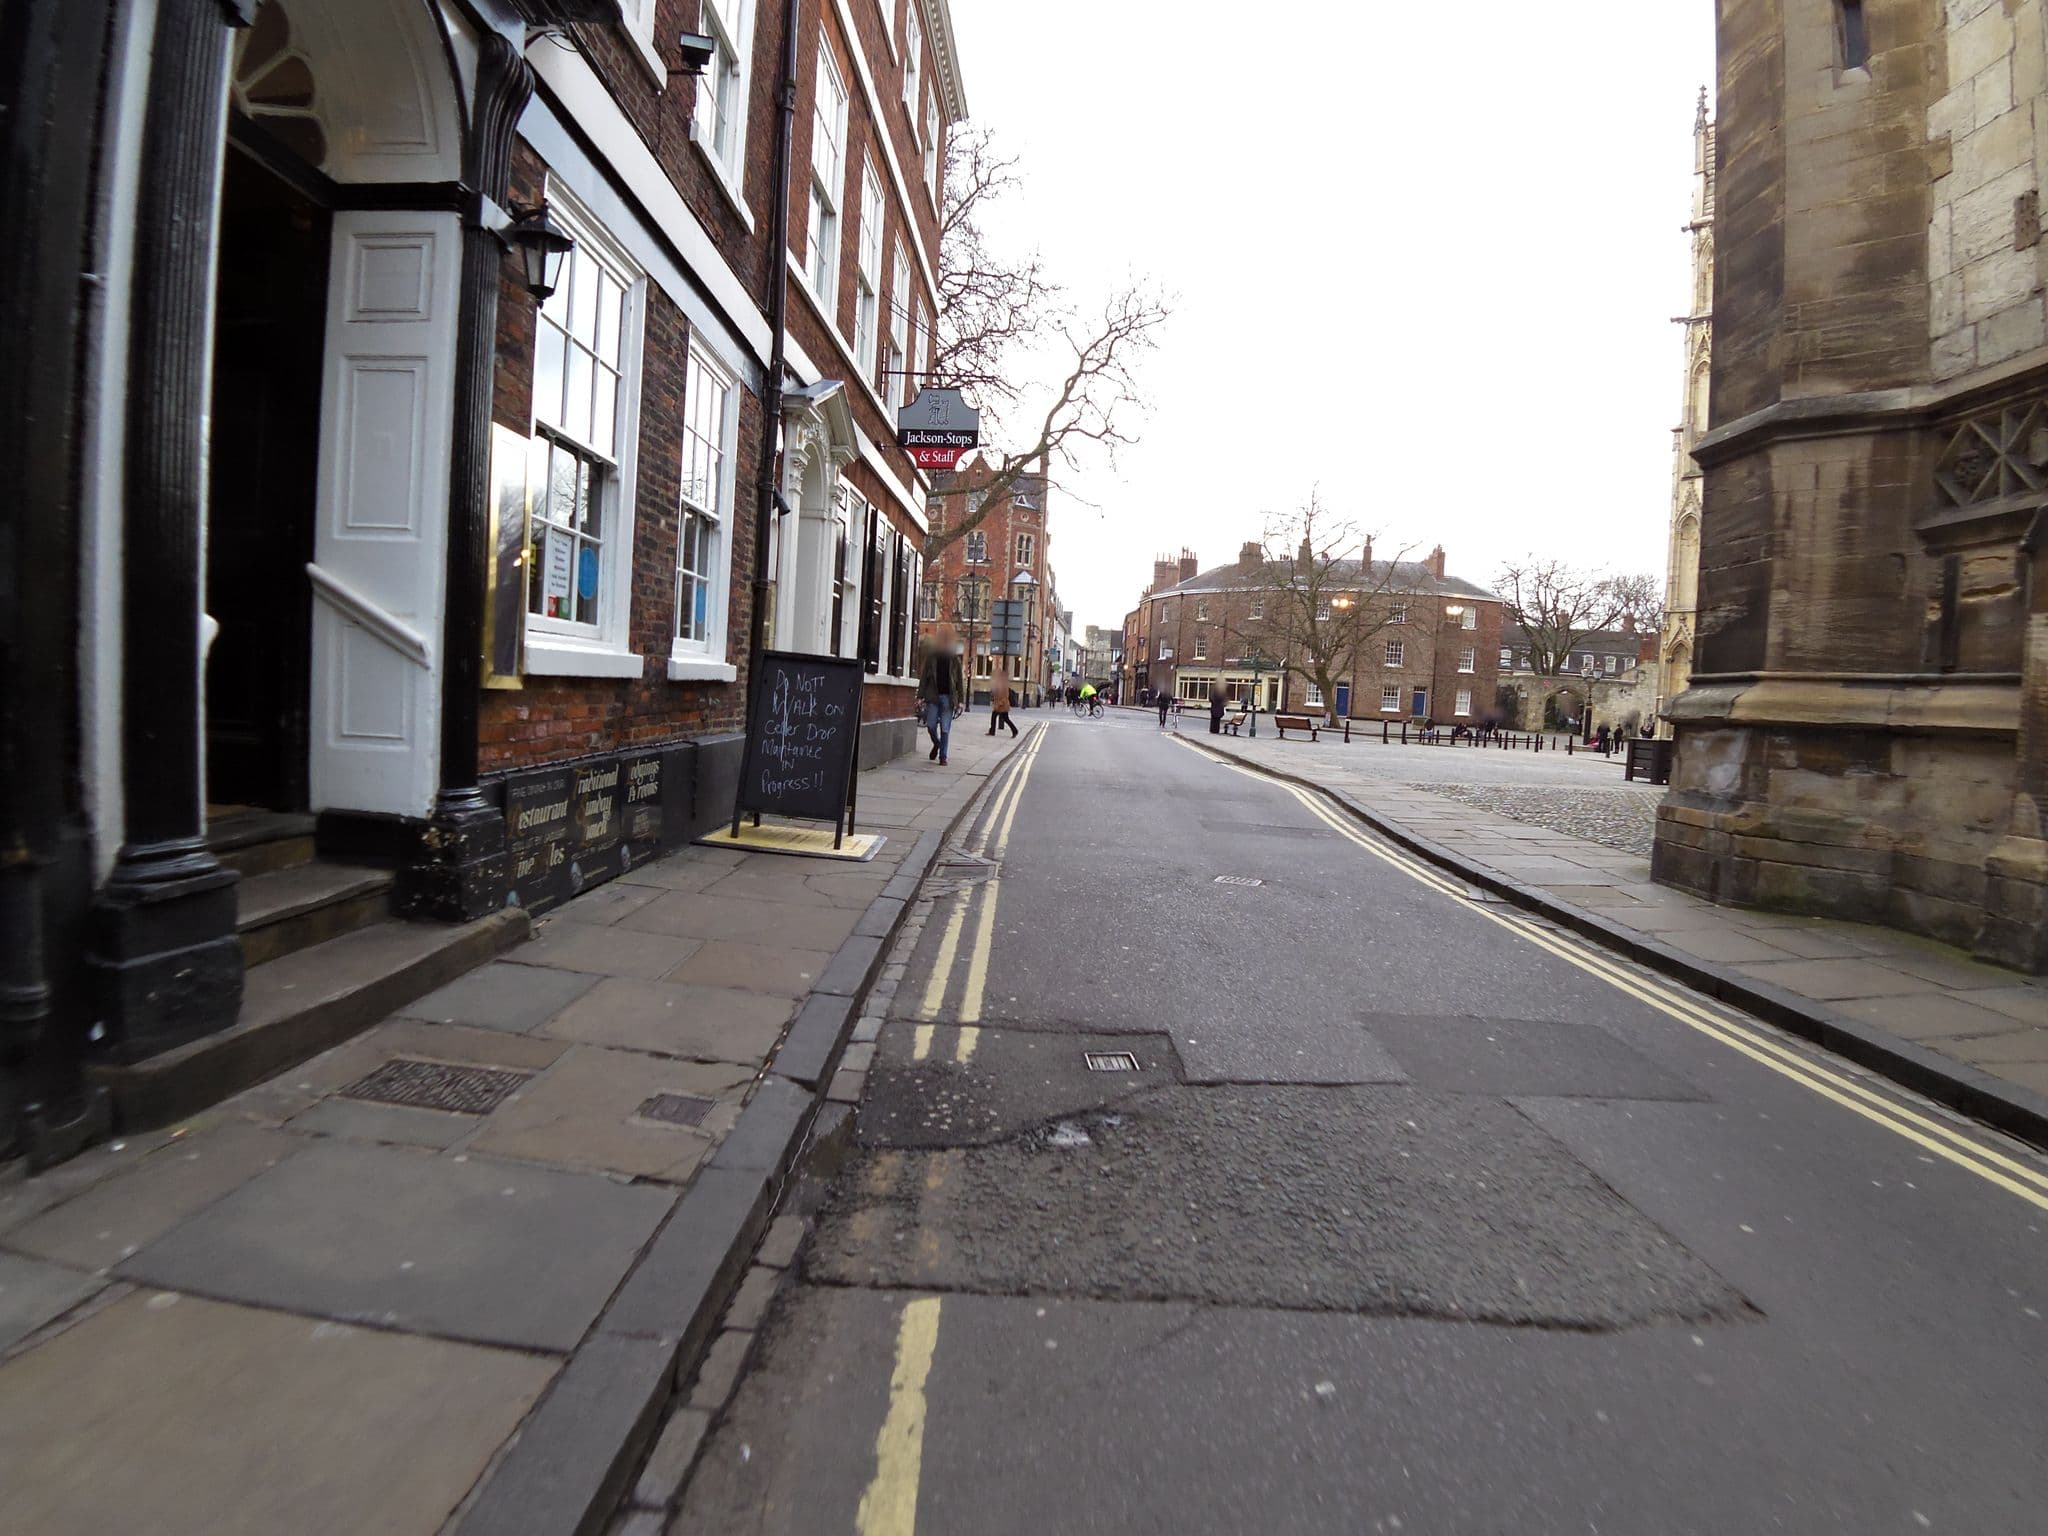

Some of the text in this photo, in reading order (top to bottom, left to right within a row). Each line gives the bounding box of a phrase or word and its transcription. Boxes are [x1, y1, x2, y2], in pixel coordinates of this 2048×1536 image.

[904, 431, 973, 447] Jackson-Stops
[919, 450, 955, 462] & Staff
[761, 769, 810, 798] Progress
